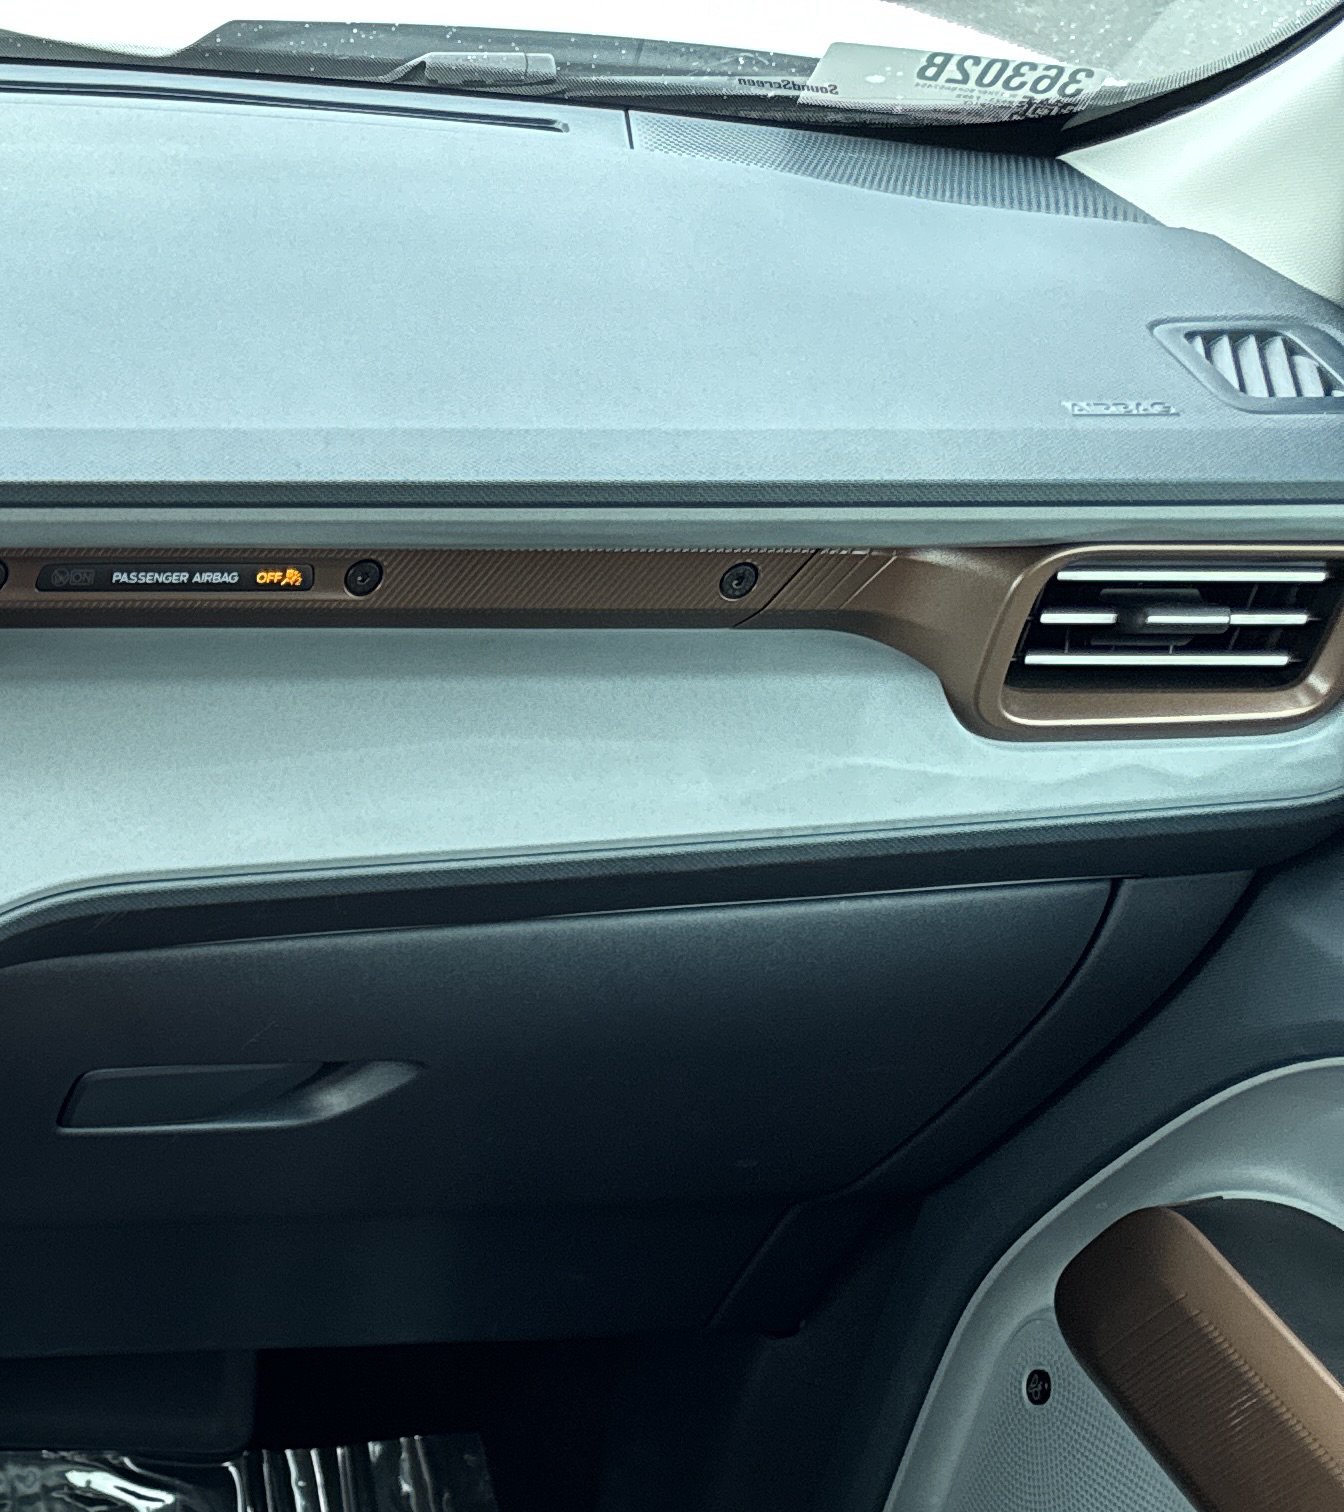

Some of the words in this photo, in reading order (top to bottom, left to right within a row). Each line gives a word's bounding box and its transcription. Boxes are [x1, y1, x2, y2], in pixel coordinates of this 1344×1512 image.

[112, 571, 189, 584] PASSENGER
[192, 571, 240, 584] AIRBAG
[256, 571, 282, 584] OFF
